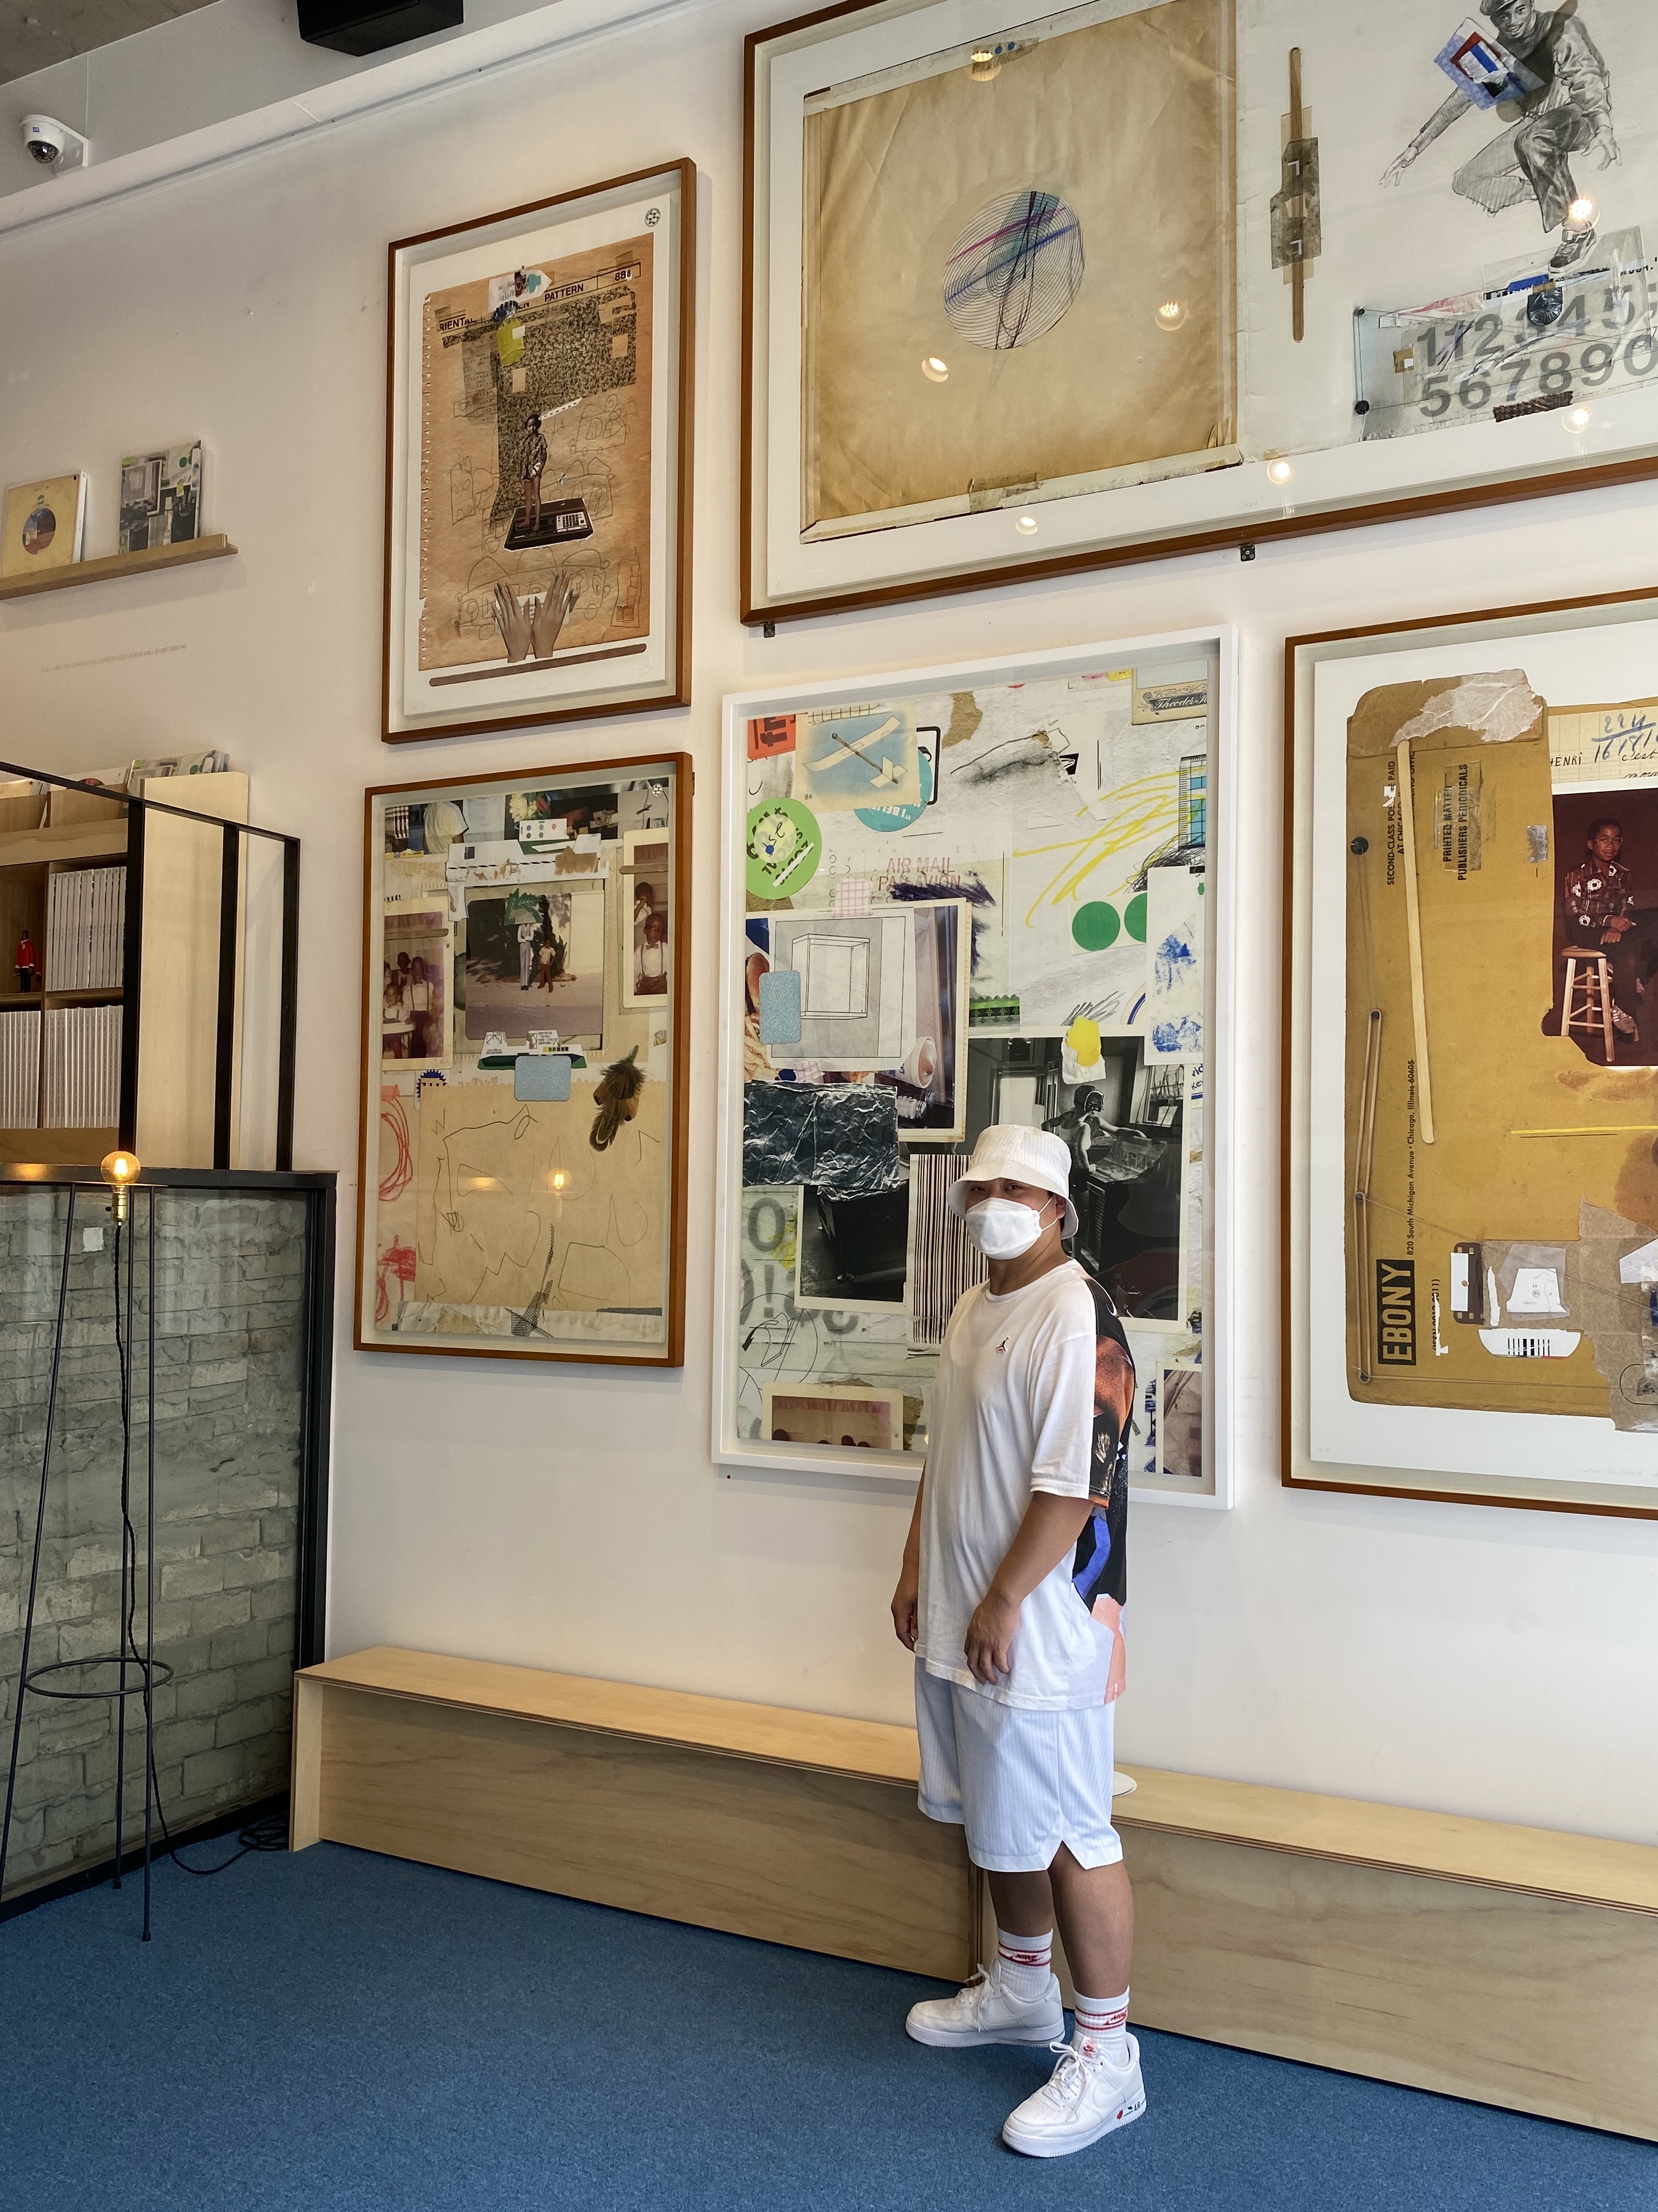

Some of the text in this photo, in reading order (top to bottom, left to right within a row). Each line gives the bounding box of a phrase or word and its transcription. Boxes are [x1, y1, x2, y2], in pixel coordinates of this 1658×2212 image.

[544, 283, 584, 302] PATTERN
[1458, 764, 1468, 881] PUBLISHERS PERIODICALS
[1387, 823, 1395, 886] SECOND-CLASS
[1443, 824, 1452, 863] PRINTED
[886, 857, 956, 873] AIR MAIL
[1407, 1112, 1416, 1144] Chicago,
[1407, 1181, 1415, 1216] Michigan
[1381, 1263, 1412, 1361] EBONY
